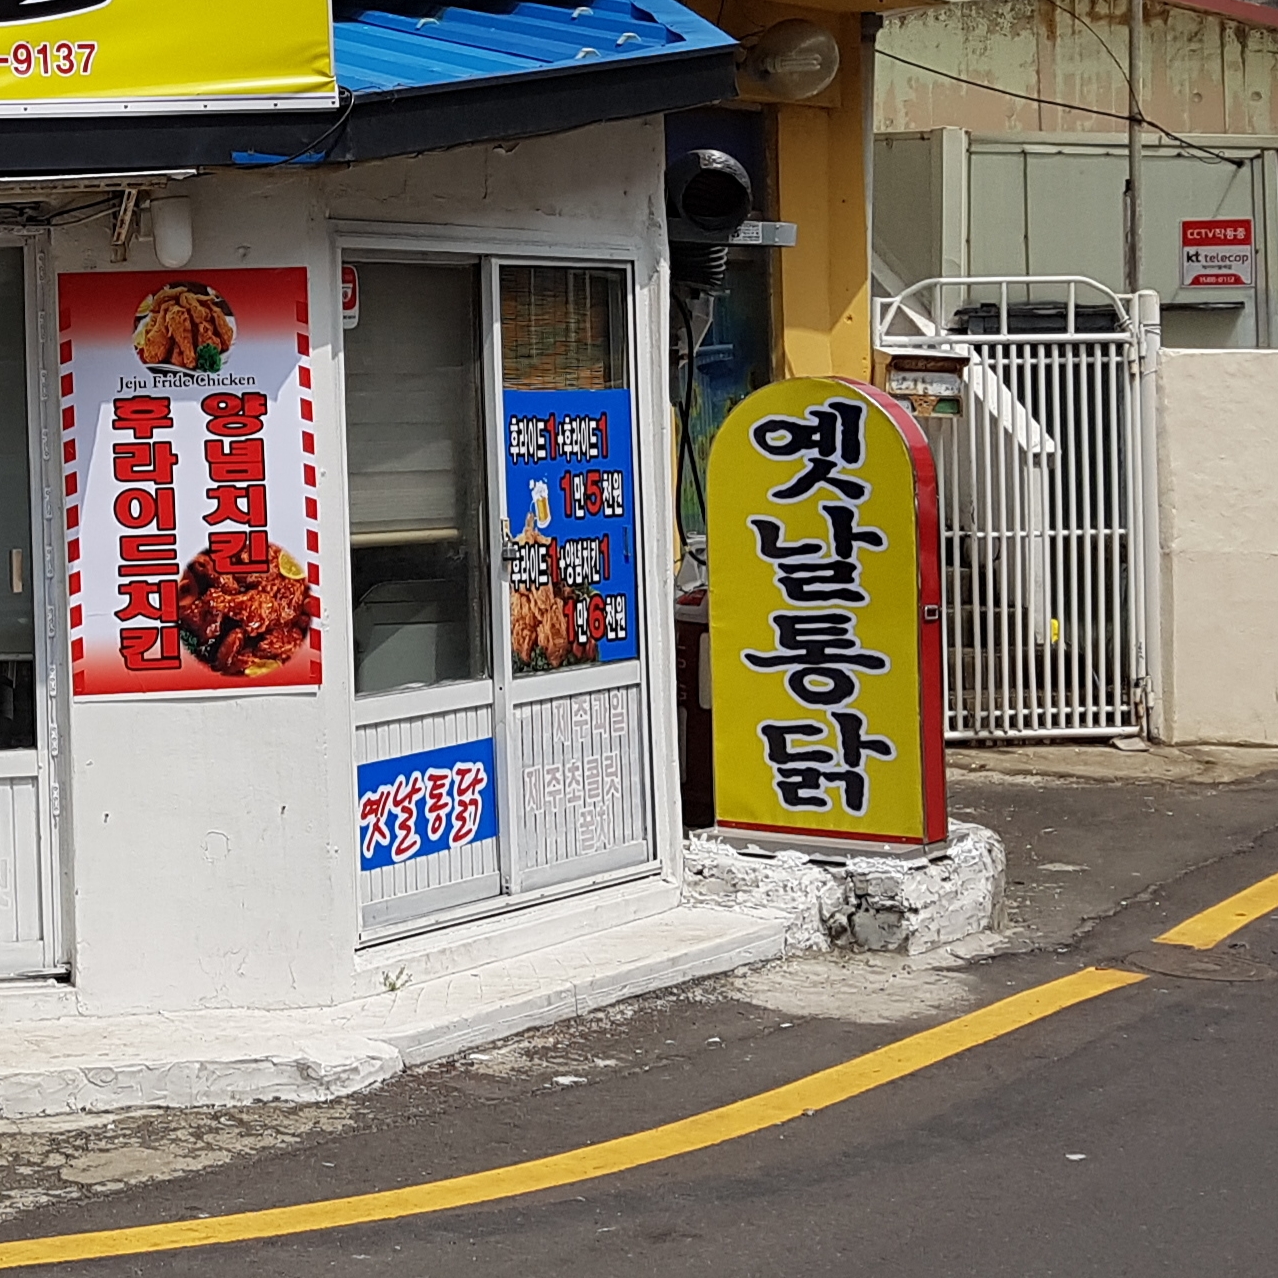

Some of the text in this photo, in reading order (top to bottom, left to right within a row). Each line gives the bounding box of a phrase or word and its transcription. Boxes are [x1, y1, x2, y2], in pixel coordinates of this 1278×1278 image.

[1186, 251, 1249, 265] kt telecop
[1187, 227, 1246, 239] CCTV작동중
[117, 373, 256, 392] Jeju Fride Chicken
[201, 392, 271, 576] 양념치킨
[561, 472, 623, 518] 1만5천원
[112, 395, 183, 671] 후라이드치킨
[564, 593, 626, 643] 1만6천원
[741, 397, 896, 815] 옛날통닭
[360, 763, 486, 859] 옛날통닭
